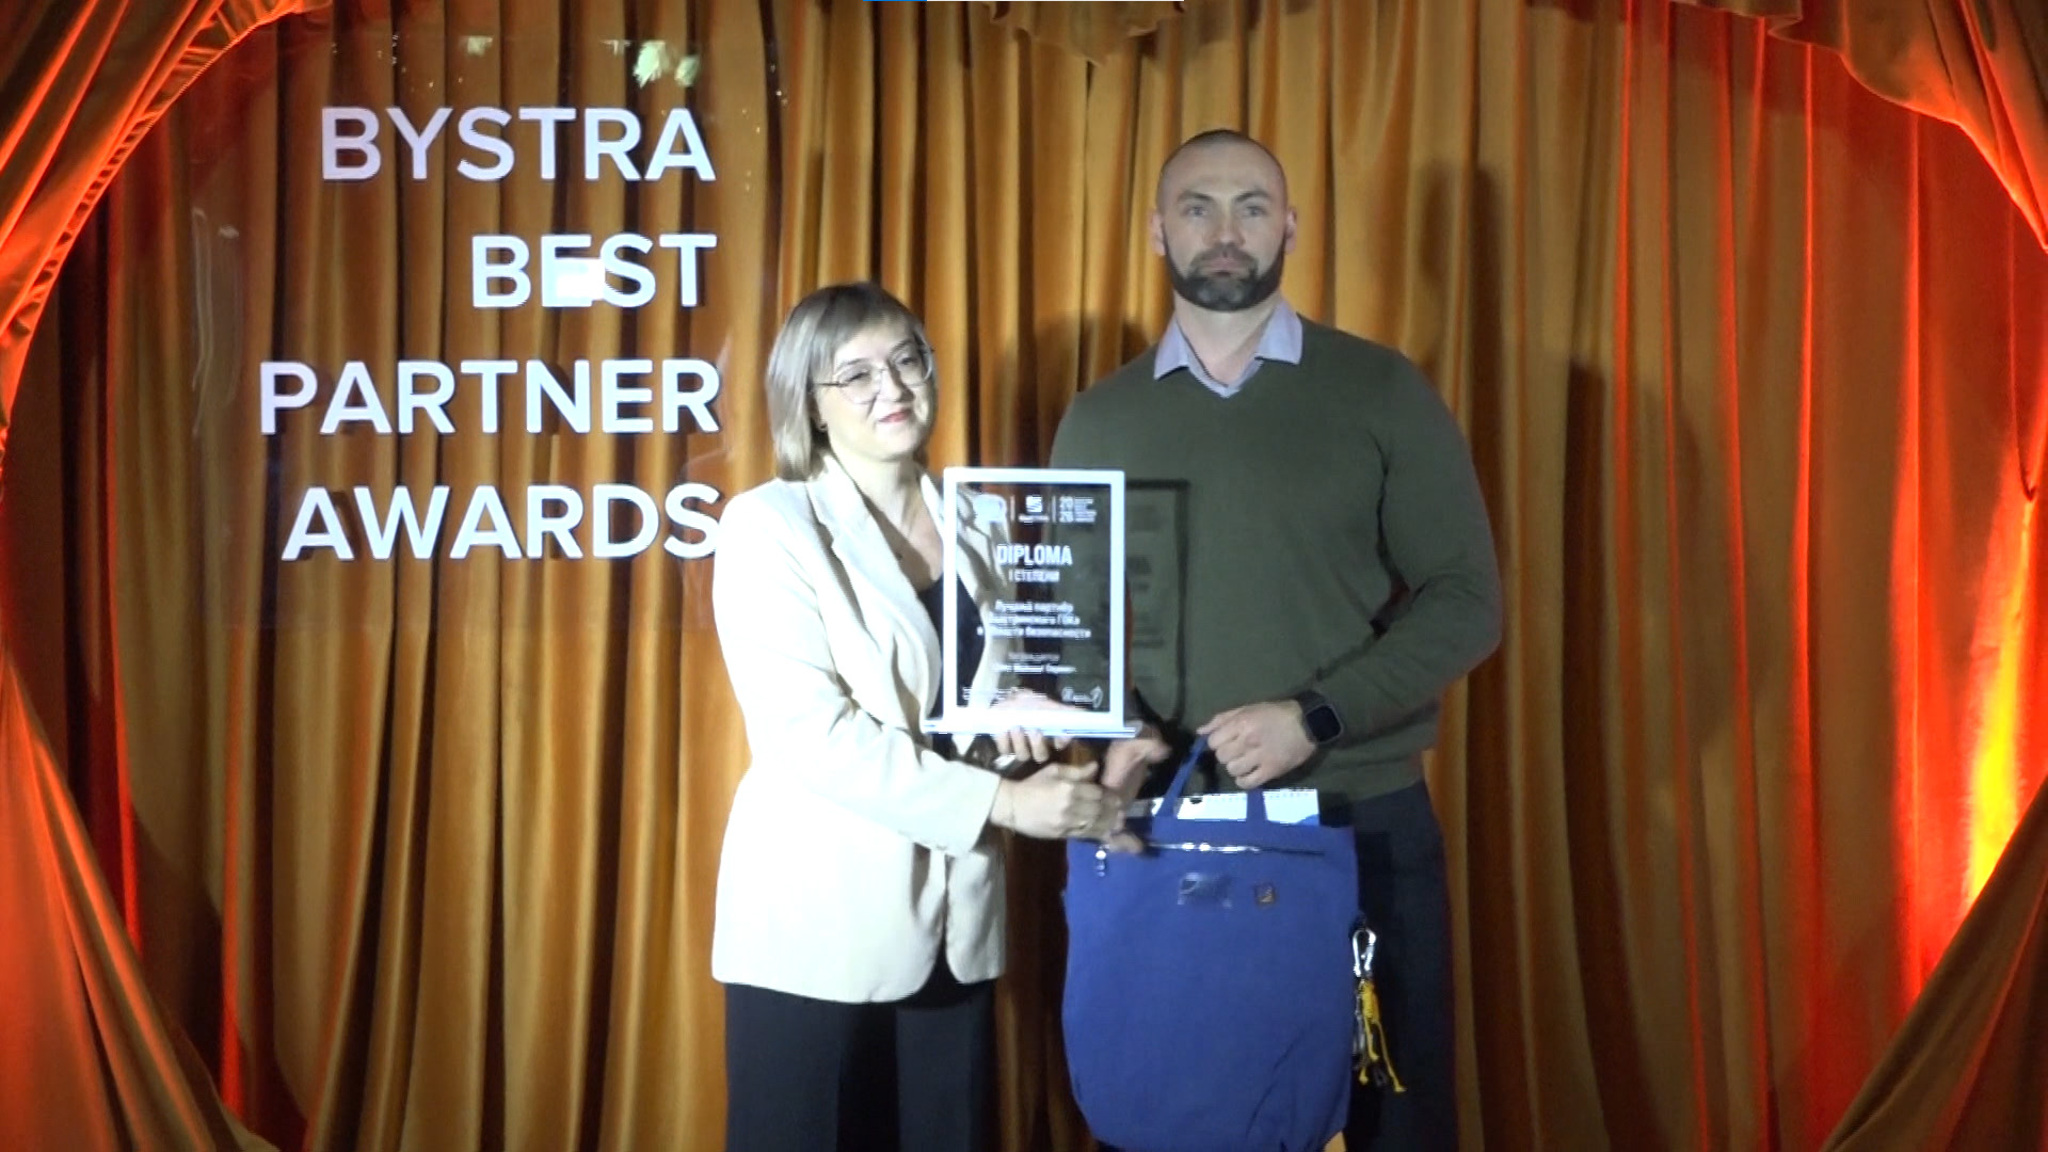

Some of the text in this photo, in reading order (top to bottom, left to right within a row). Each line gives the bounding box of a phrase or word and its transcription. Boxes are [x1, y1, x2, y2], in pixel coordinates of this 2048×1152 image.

[321, 107, 716, 180] BYSTRA
[472, 233, 717, 308] BEST
[260, 359, 720, 435] PARTNER
[281, 484, 720, 560] AWARDS
[997, 544, 1073, 566] DIPLOMA
[1014, 570, 1060, 582] СТЕПЕНИ
